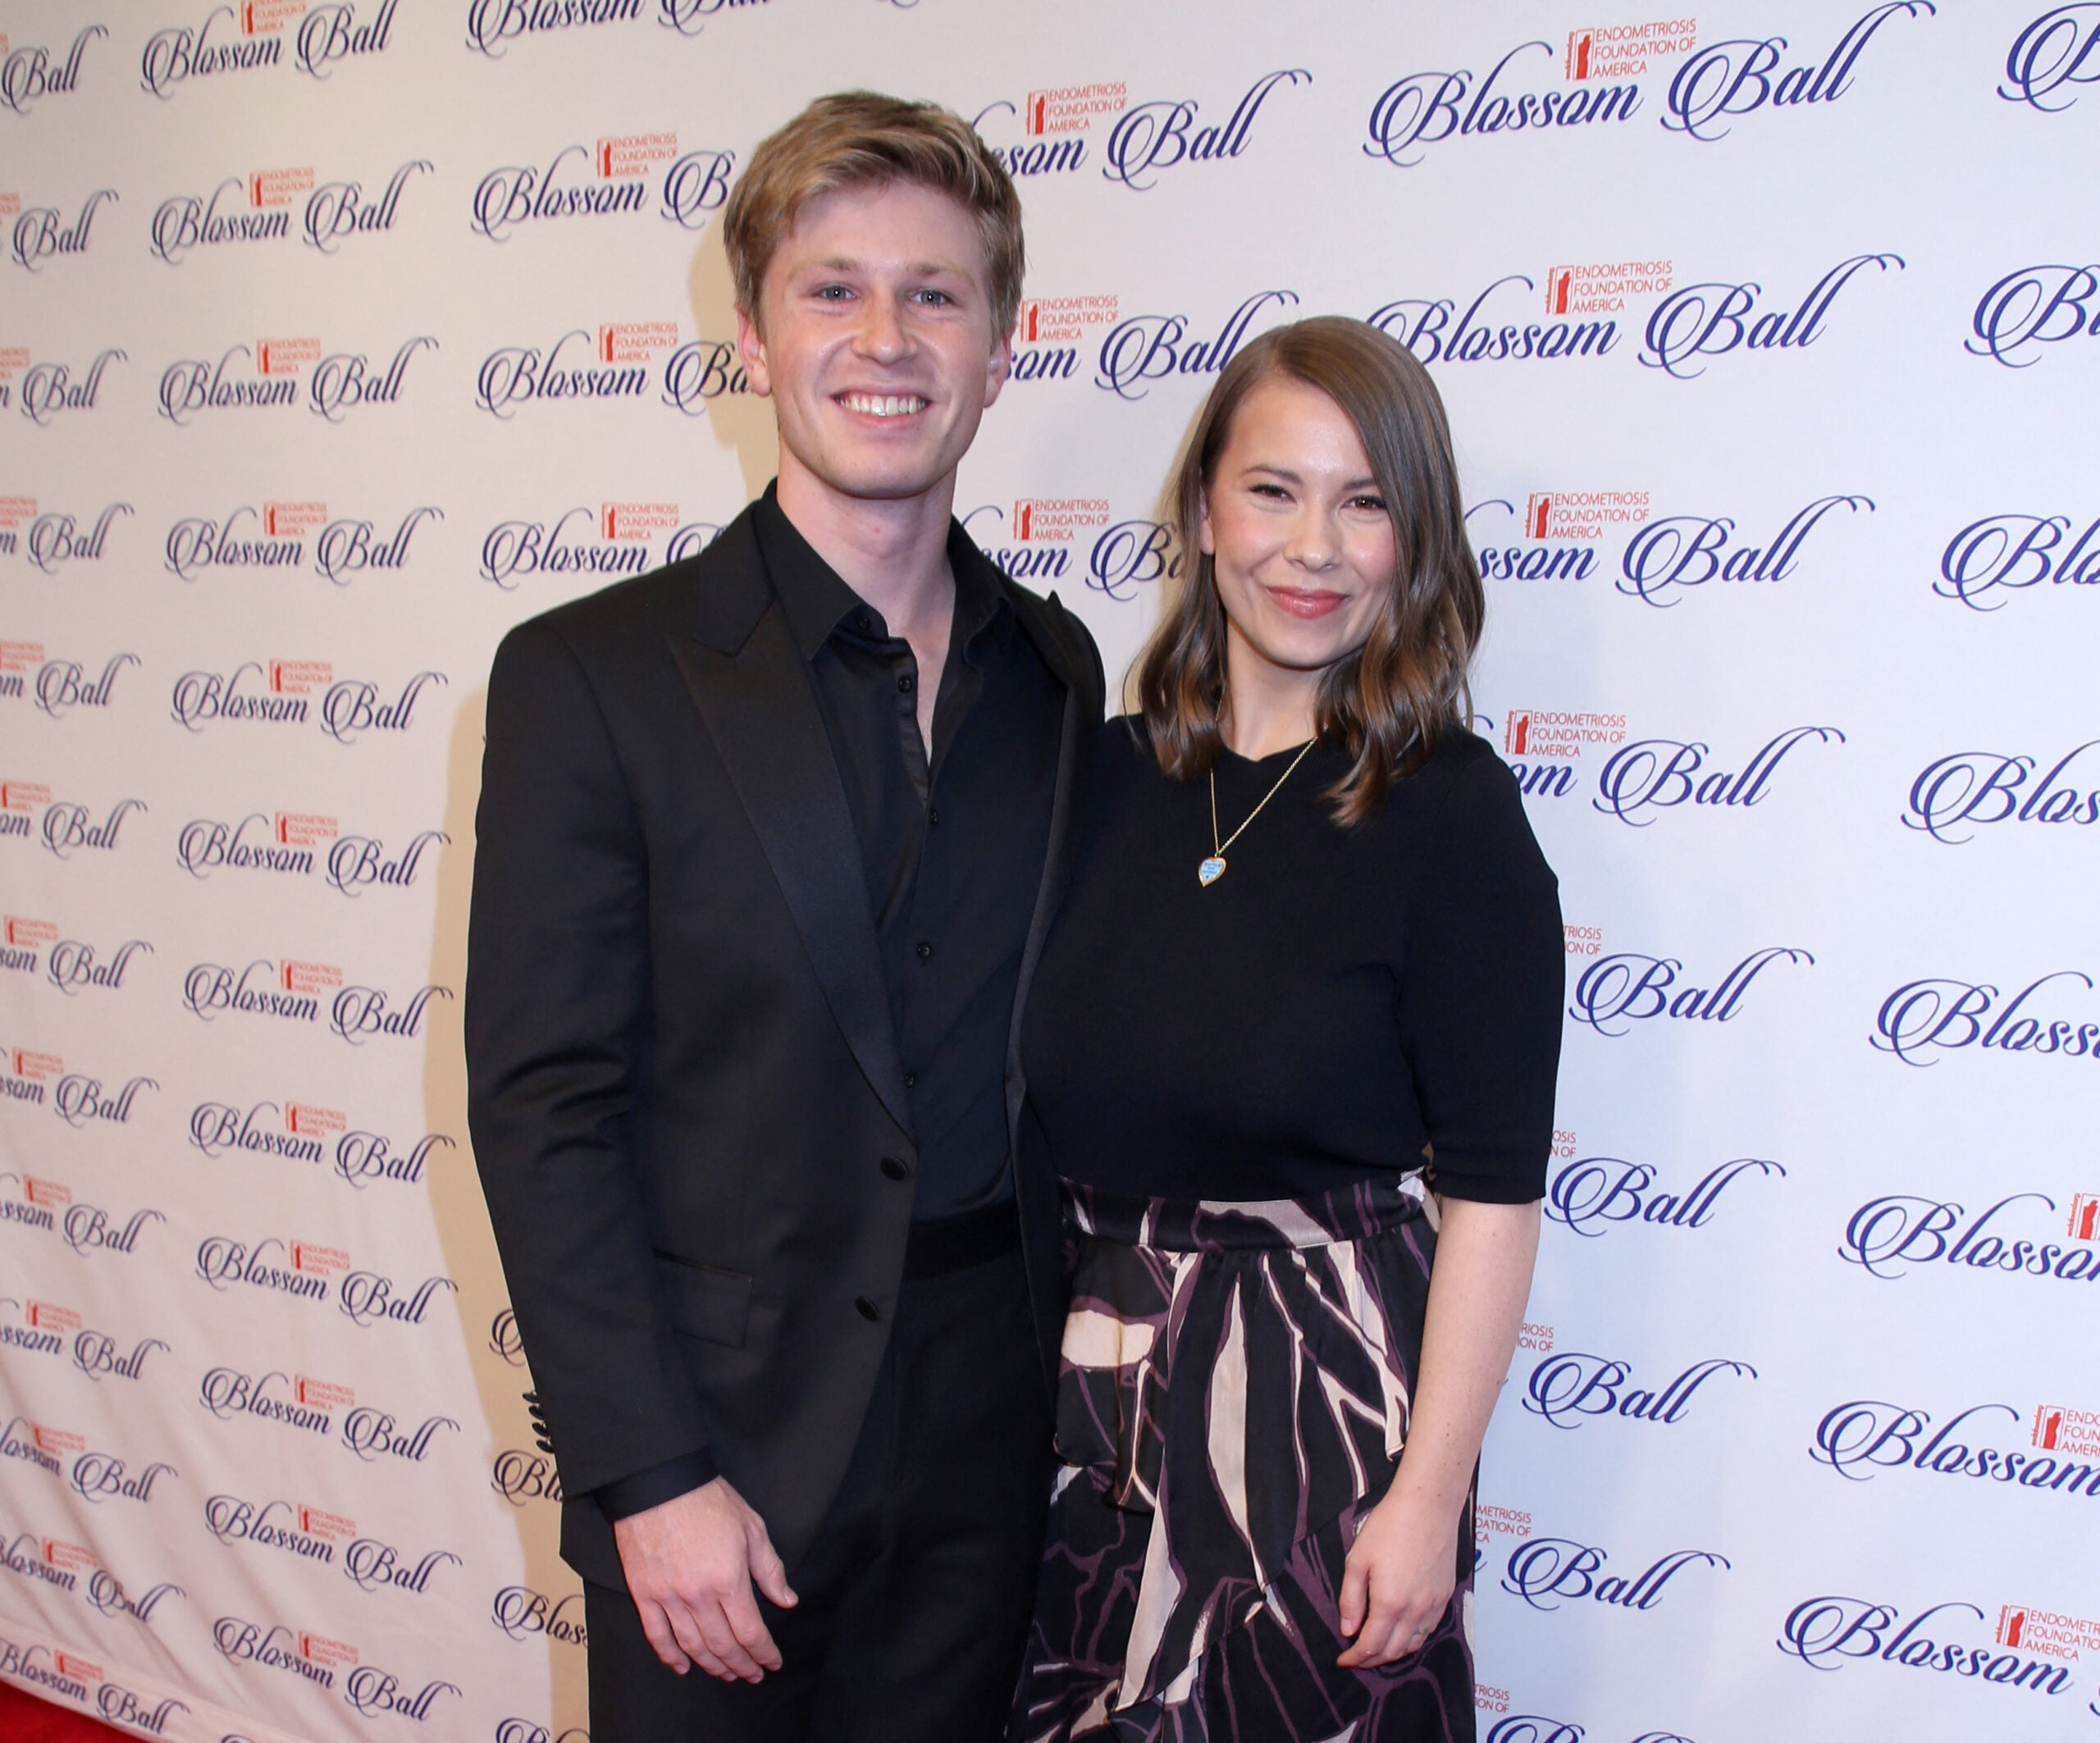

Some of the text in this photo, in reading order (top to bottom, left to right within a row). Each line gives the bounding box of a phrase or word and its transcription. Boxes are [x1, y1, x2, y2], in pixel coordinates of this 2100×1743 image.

[140, 0, 399, 100] Blossom Ball
[1595, 36, 1696, 60] FOUNDATION OF
[1596, 19, 1696, 42] ENDOMETRIOSIS
[0, 24, 109, 116] Ball
[1048, 82, 1126, 100] ENDOMETRIOSIS
[1363, 41, 1645, 167] Blossom
[1660, 0, 1937, 142] Ball
[1593, 61, 1646, 78] AMERICA
[1048, 98, 1126, 116] FOUNDATION OF
[1048, 116, 1090, 133] AMERICA
[1102, 68, 1312, 191] Ball
[149, 159, 435, 266] Blossom Ball
[470, 144, 650, 243] Blossom
[11, 189, 119, 273] Ball
[1574, 277, 1672, 296] FOUNDATION OF
[1576, 261, 1672, 279] ENDOMETRIOSIS
[1042, 295, 1118, 310] ENDOMETRIOSIS
[1042, 309, 1118, 325] FOUNDATION OF
[1366, 276, 1623, 367] Blossom
[1638, 253, 1906, 380] Ball
[1573, 299, 1624, 313] AMERICA
[1042, 328, 1082, 341] AMERICA
[1094, 290, 1299, 400] Ball
[20, 349, 128, 427] Ball
[158, 336, 439, 427] Blossom Ball
[475, 329, 750, 420] Blossom Ba
[1034, 513, 1109, 526] FOUNDATION OF
[1035, 499, 1109, 511] ENDOMETRIOSIS
[1554, 492, 1649, 505] ENDOMETRIOSIS
[1554, 509, 1649, 522] FOUNDATION OF
[27, 503, 135, 575] Ball
[164, 506, 445, 586] Blossom Ball
[479, 507, 652, 591] Blossom
[1034, 529, 1074, 541] AMERICA
[1551, 526, 1602, 538] AMERICA
[1614, 495, 1876, 609] Ball
[34, 653, 141, 719] Ball
[171, 662, 449, 745] Blossom Ball
[1532, 728, 1626, 742] FOUNDATION OF
[1534, 712, 1626, 727] ENDOMETRIOSIS
[1531, 744, 1581, 757] AMERICA
[1591, 725, 1847, 828] Ball
[1901, 738, 2100, 845] Blos
[41, 799, 148, 860] Ball
[176, 813, 451, 898] Blossom Ball
[1563, 924, 1601, 940] TRIOSIS
[1586, 942, 1600, 955] OF
[47, 940, 154, 996] Ball
[1568, 947, 1815, 1038] Ball
[182, 960, 454, 1046] Blossom Ball
[1869, 971, 2100, 1068] Bloss
[53, 1074, 160, 1129] Ball
[189, 1102, 456, 1189] Blossom Ball
[1561, 1146, 1576, 1158] OF
[1543, 1157, 1787, 1238] Ball
[62, 1204, 167, 1257] Ball
[1838, 1193, 2100, 1281] Blosso
[195, 1236, 330, 1300] Blossom
[339, 1271, 459, 1328] Ball
[72, 1330, 171, 1382] Ball
[1539, 1340, 1553, 1352] OF
[199, 1367, 332, 1434] Blossom
[341, 1407, 460, 1462] Ball
[1522, 1353, 1758, 1430] Ball
[0, 1417, 62, 1476] lossom
[69, 1452, 178, 1504] Ball
[1808, 1399, 2100, 1498] Blossom
[2061, 1441, 2100, 1458] AMER
[1476, 1517, 1532, 1536] DATION OF
[1477, 1505, 1532, 1523] METRIOSIS
[204, 1494, 336, 1563] Blossom
[343, 1538, 463, 1593] Ball
[0, 1533, 76, 1592] lossom
[85, 1568, 187, 1622] Ball
[1500, 1536, 1732, 1612] Ball
[491, 1586, 589, 1641] Blos
[2027, 1624, 2100, 1650] FOUNDATIO
[2030, 1610, 2100, 1636] ENDOMETR
[212, 1616, 336, 1688] Blossom
[344, 1666, 463, 1721] Ball
[1777, 1595, 2075, 1695] Blossom
[2025, 1640, 2079, 1662] AMERICA
[96, 1683, 191, 1736] Ball
[1475, 1683, 1509, 1701] TRIOSIS
[1495, 1702, 1509, 1713] OF
